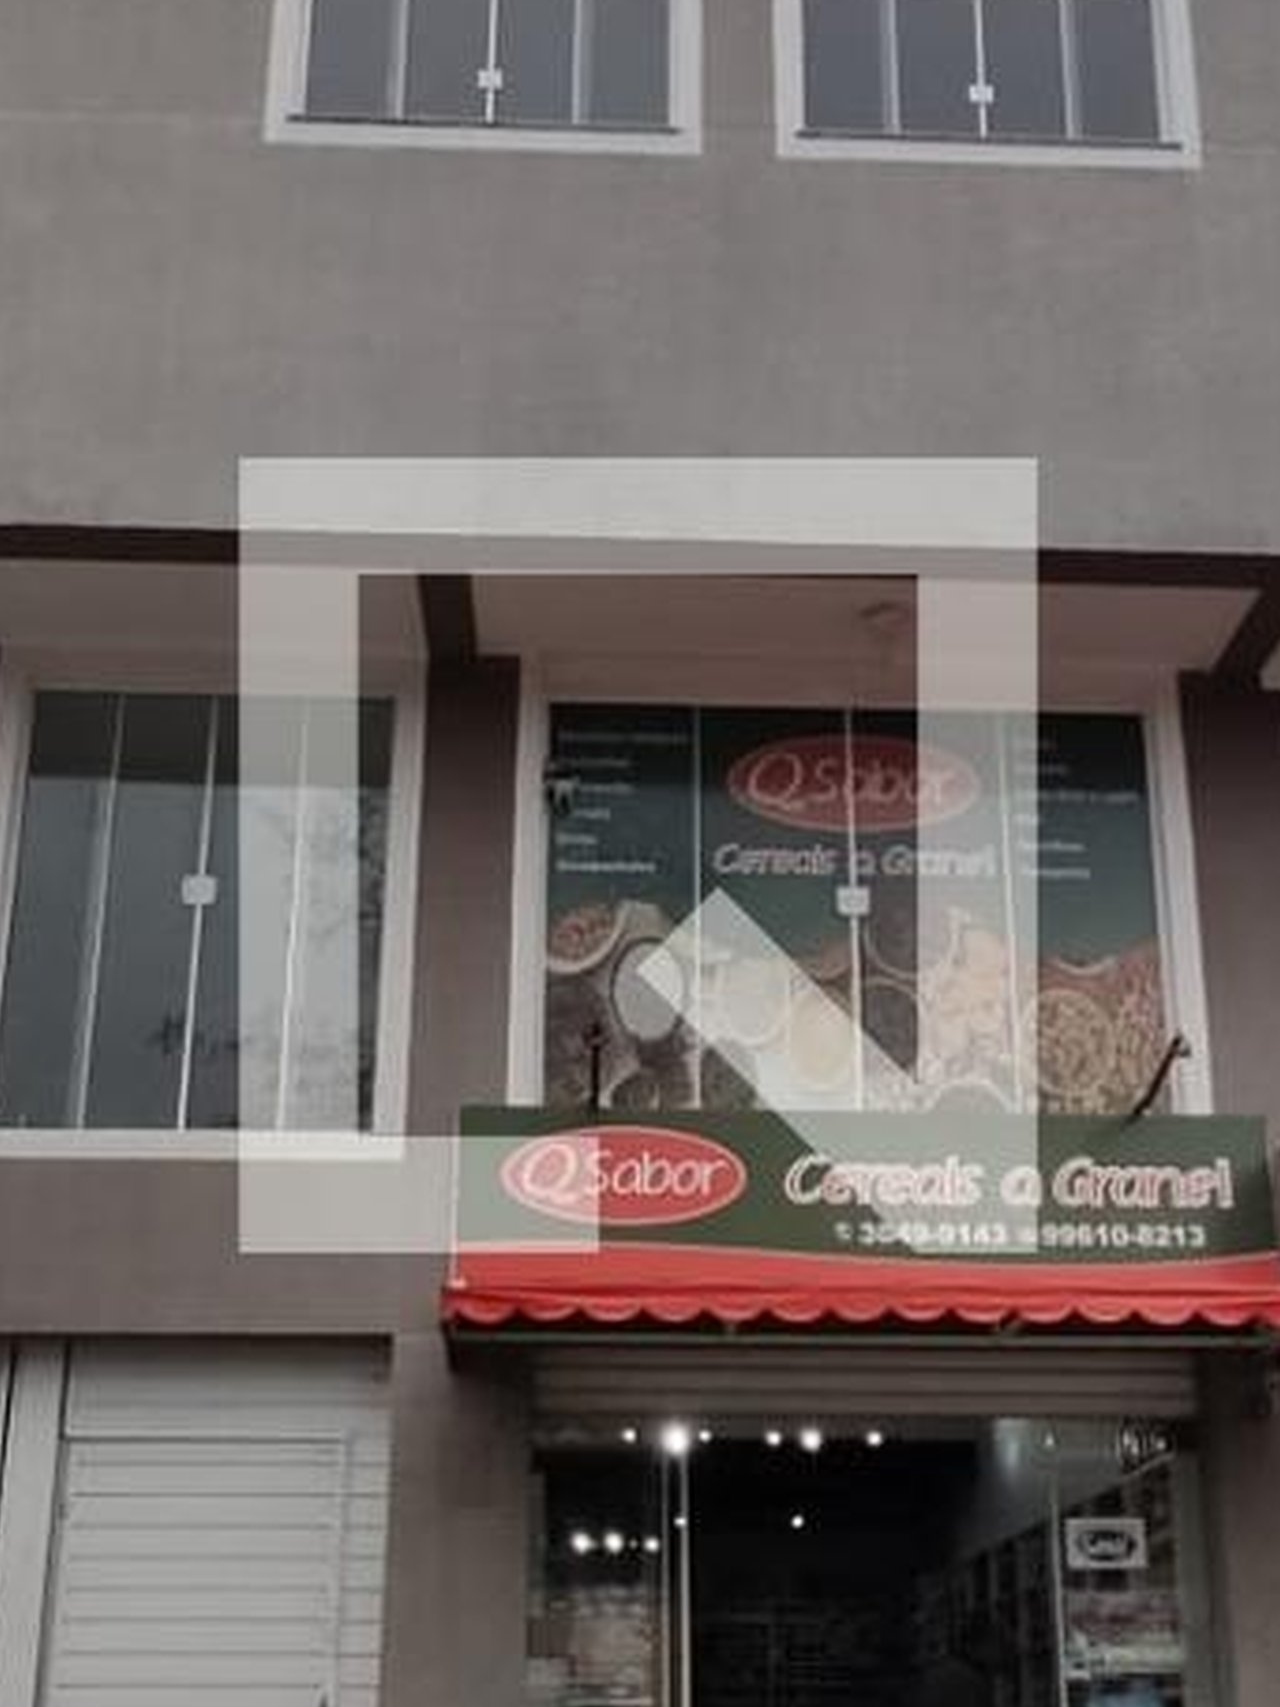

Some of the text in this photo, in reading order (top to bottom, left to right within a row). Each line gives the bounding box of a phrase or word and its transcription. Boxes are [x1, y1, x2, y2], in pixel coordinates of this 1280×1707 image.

[714, 844, 837, 875] Cereais
[881, 845, 999, 876] Granel
[784, 1154, 1235, 1209] Cereais a Granel
